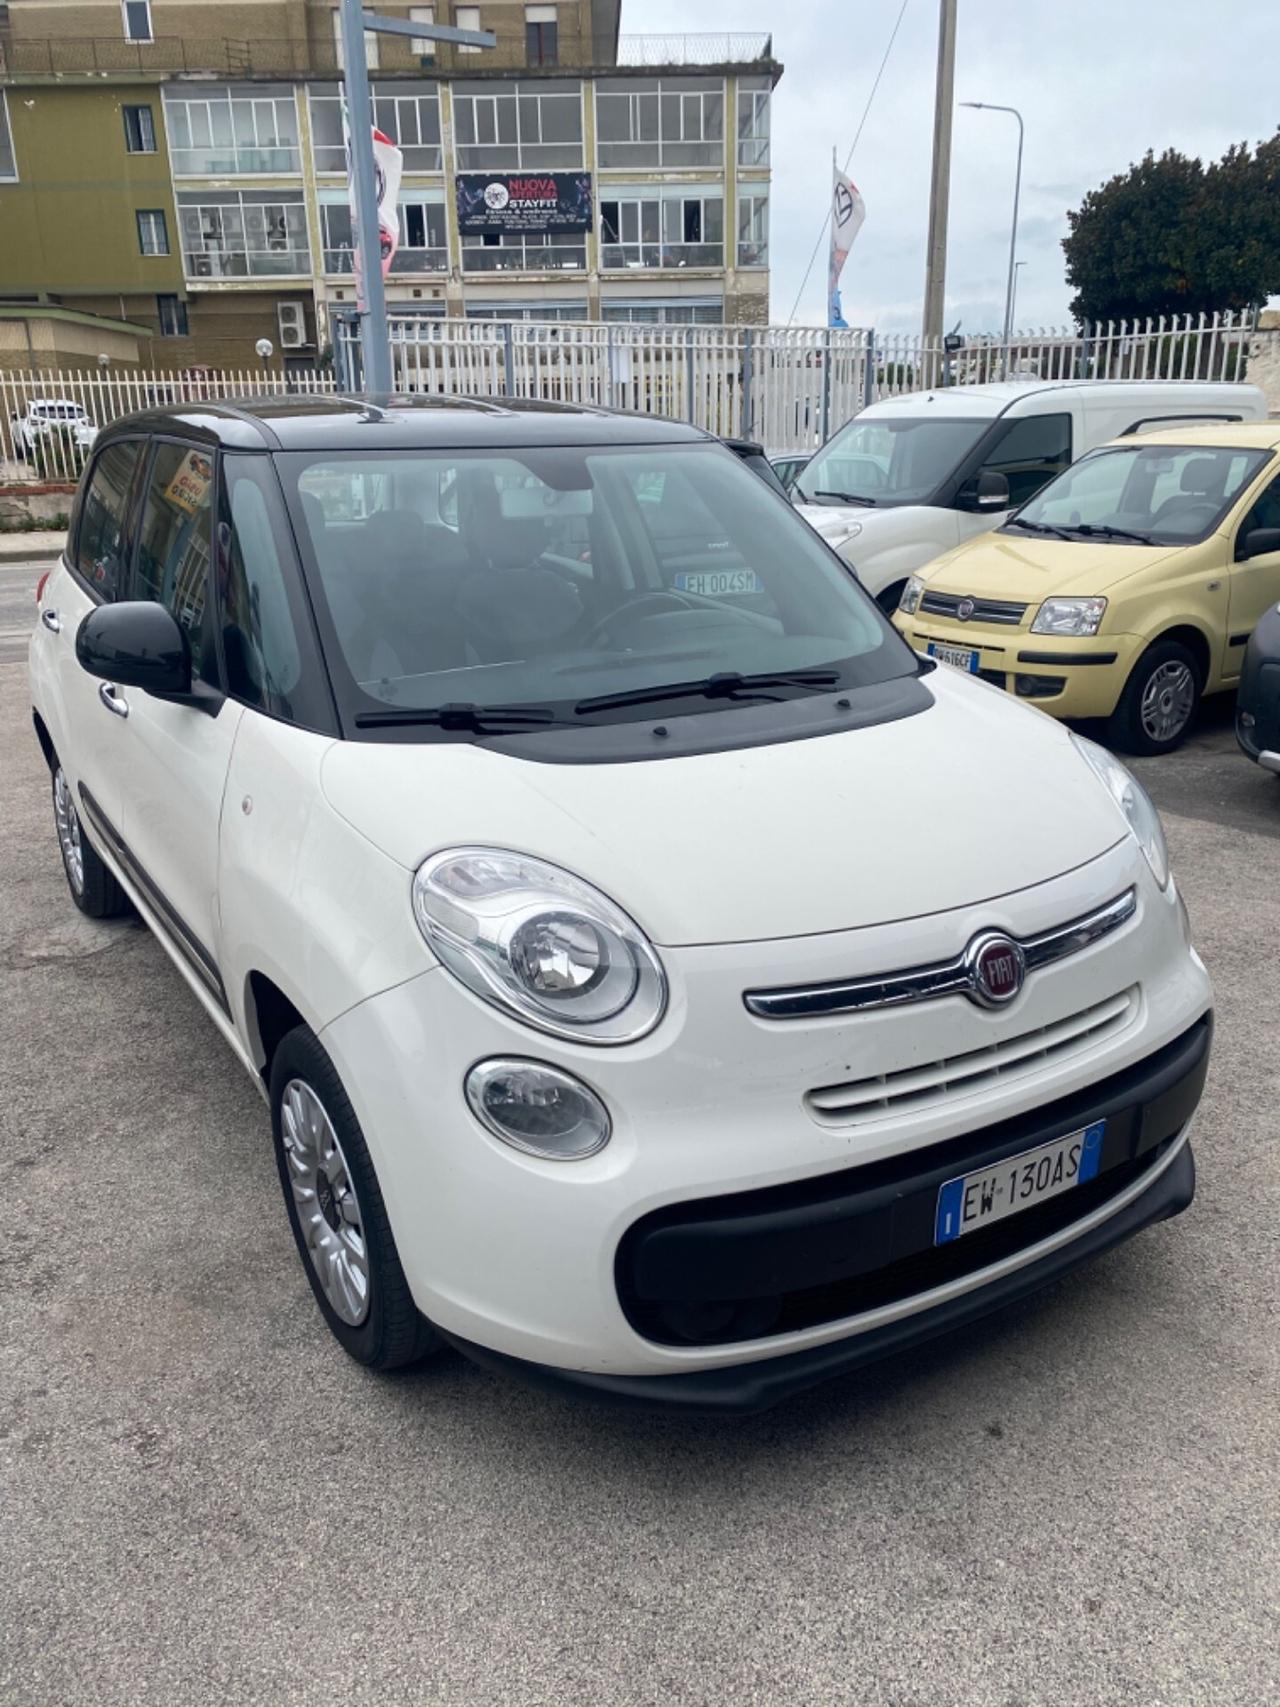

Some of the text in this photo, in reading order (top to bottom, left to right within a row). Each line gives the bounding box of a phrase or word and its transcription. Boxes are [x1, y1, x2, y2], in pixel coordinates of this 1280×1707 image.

[508, 178, 557, 191] NUOVA
[509, 199, 557, 209] STAYFIT
[986, 955, 1014, 987] FIAT
[963, 1144, 1082, 1223] EW 130AS
